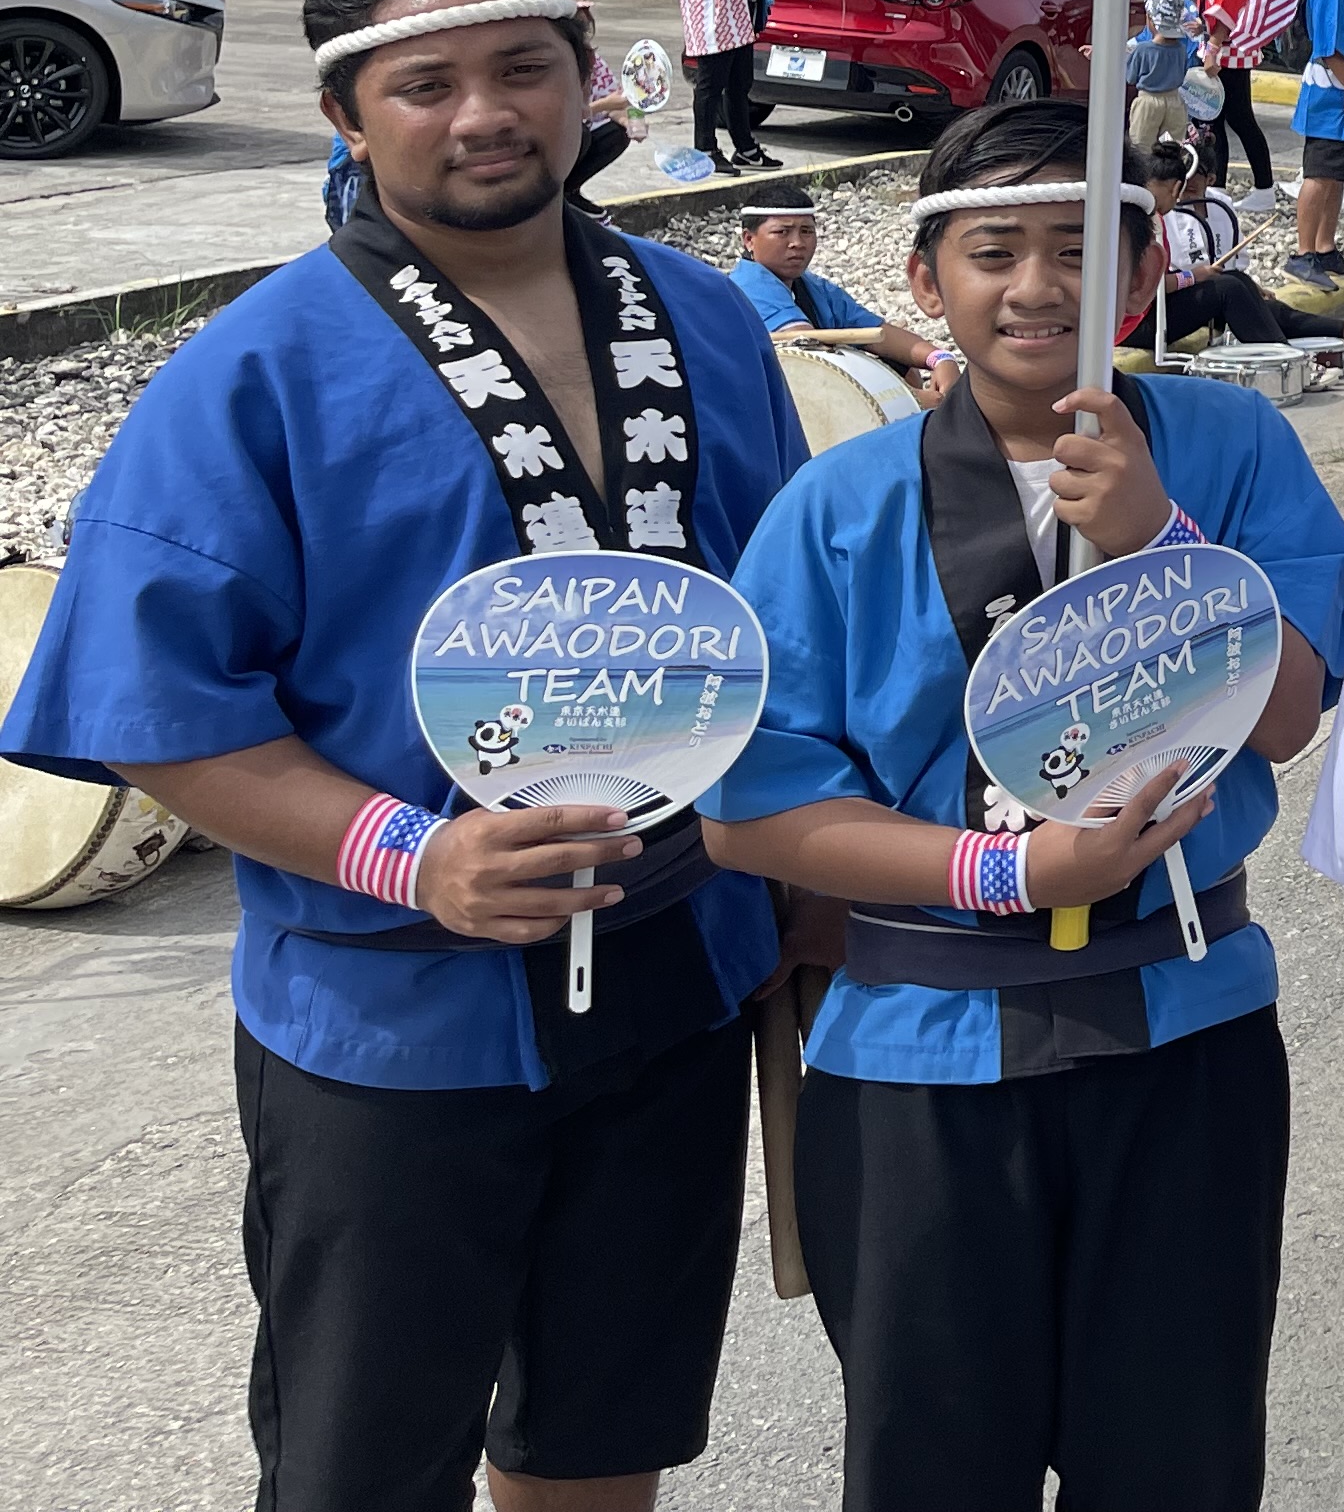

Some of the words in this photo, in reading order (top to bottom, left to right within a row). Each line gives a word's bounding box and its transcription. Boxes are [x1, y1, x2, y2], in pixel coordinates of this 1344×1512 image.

[601, 255, 657, 331] SAIPAN
[390, 264, 474, 353] SAIPAN
[438, 348, 600, 554] 天水連
[609, 338, 688, 549] 天水連
[490, 576, 689, 615] SAIPAN
[1020, 554, 1192, 655] SAIPAN
[433, 620, 741, 660] AWAODORI
[985, 578, 1248, 715] AWAODORI
[1056, 640, 1196, 721] TEAM
[507, 667, 665, 706] TEAM
